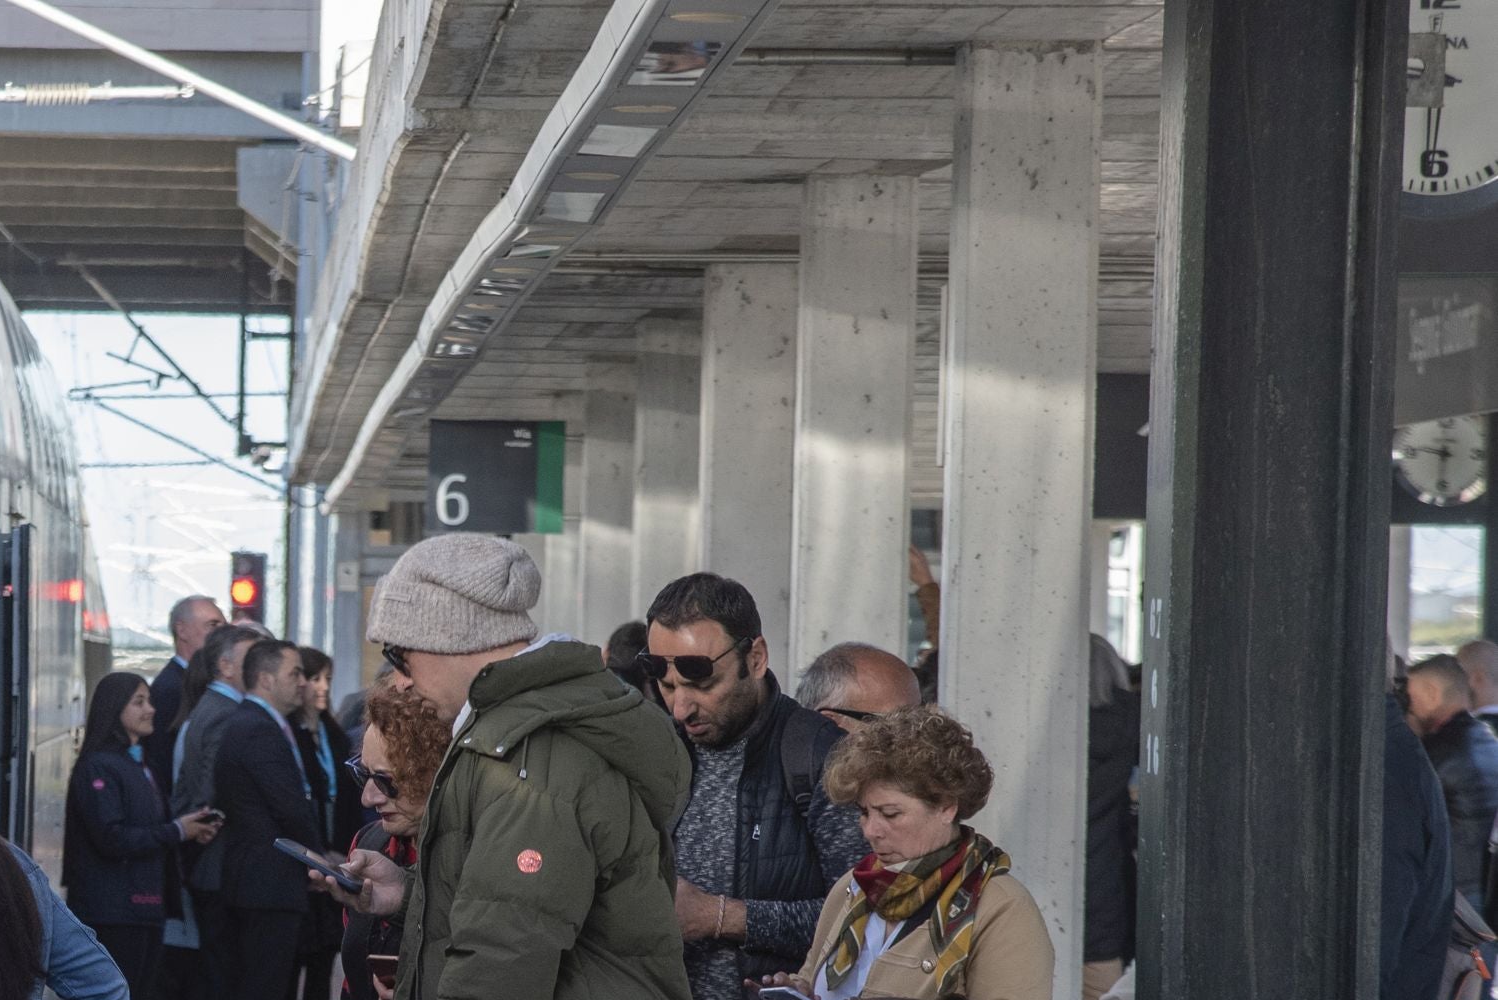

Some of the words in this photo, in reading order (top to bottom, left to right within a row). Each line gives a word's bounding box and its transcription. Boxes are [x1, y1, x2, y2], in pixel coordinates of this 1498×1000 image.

[1420, 150, 1448, 178] 6
[436, 472, 469, 526] 6
[1149, 598, 1162, 639] 67
[1151, 669, 1157, 708] 6
[1147, 734, 1159, 775] 16
